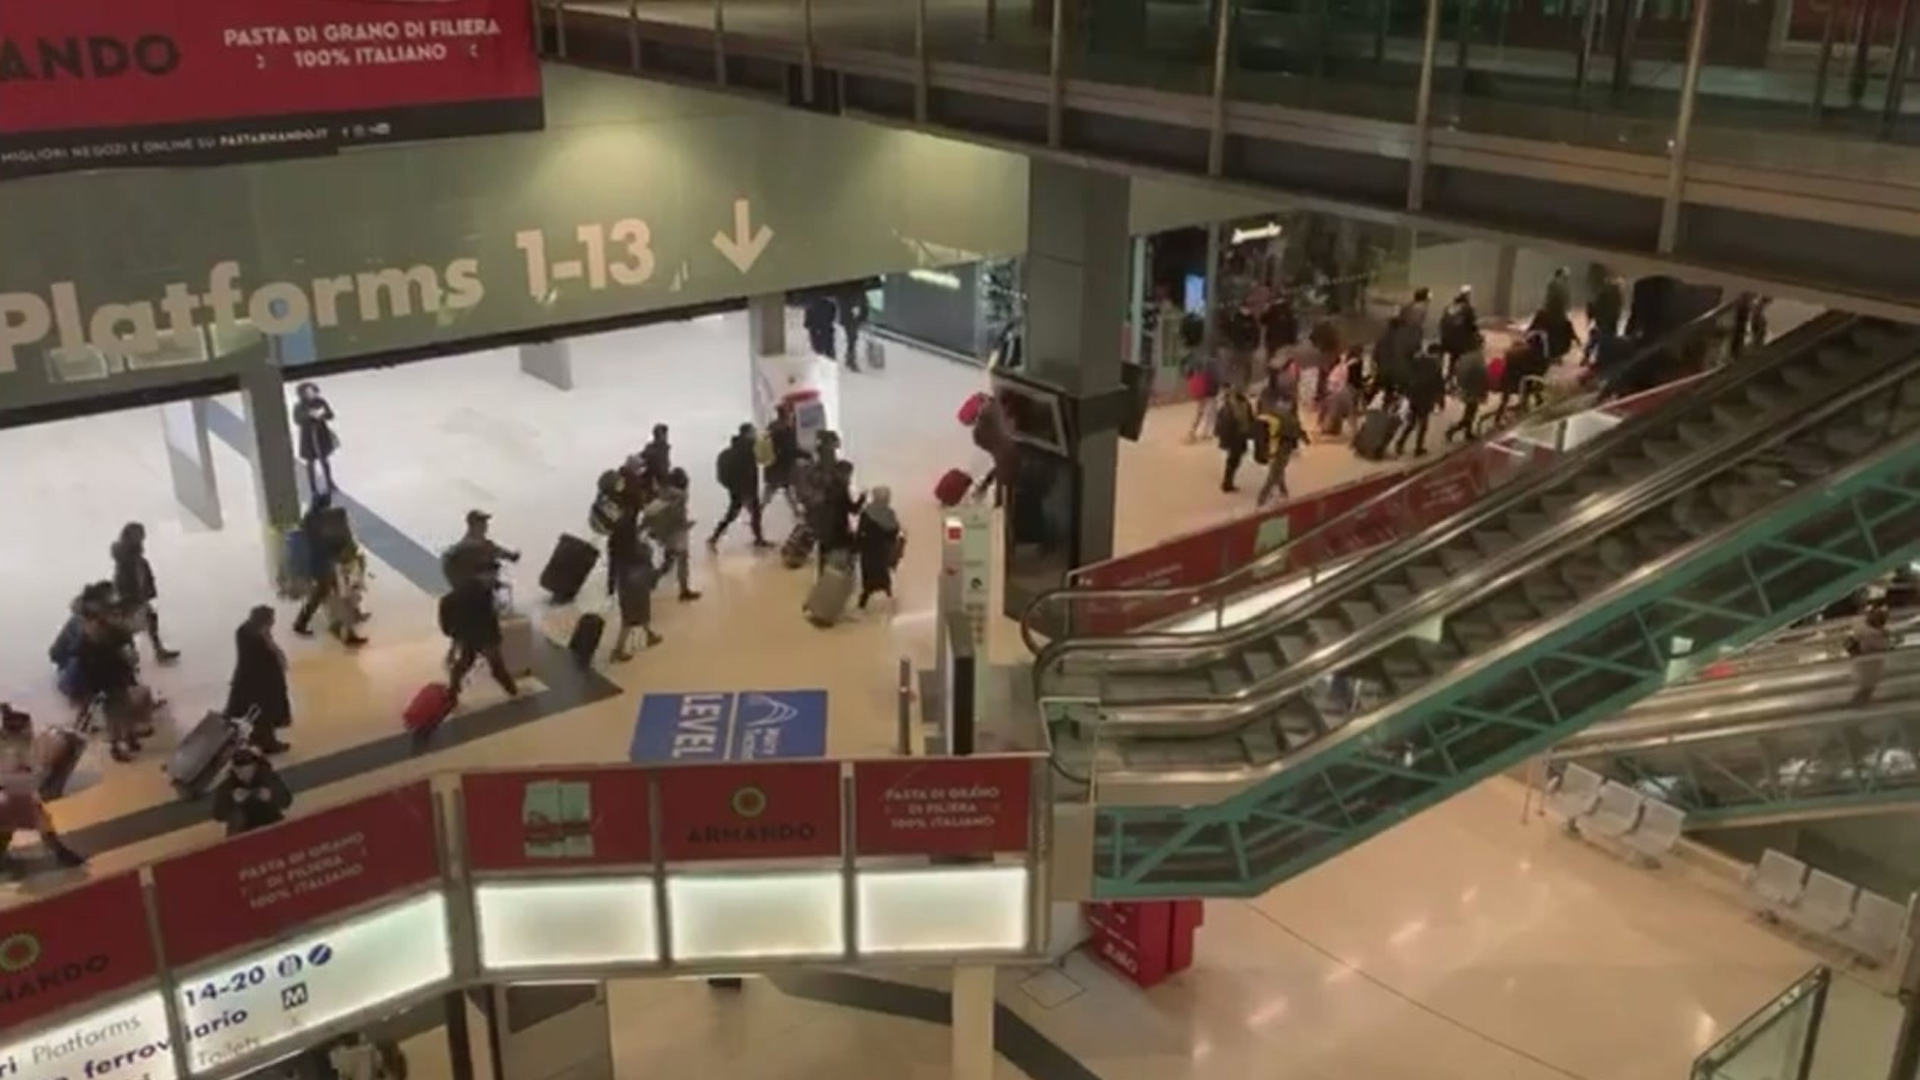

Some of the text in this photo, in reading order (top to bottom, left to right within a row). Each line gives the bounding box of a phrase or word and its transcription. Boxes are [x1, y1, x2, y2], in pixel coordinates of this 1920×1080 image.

[224, 18, 500, 47] PASTA DI GRANO DI FILIERA
[294, 43, 447, 67] 100% ITALIANO
[71, 143, 128, 158] NEGOZI
[132, 141, 139, 154] E
[143, 139, 193, 152] ONLINE
[197, 137, 216, 149] SU
[0, 218, 656, 372] Platforms 1-13
[672, 694, 724, 759] LEVEL
[686, 823, 816, 844] ARMANDO
[239, 858, 286, 881] PASTA
[308, 831, 365, 857] GRANO
[32, 1015, 142, 1065] Platforms
[185, 965, 265, 1007] 14-20
